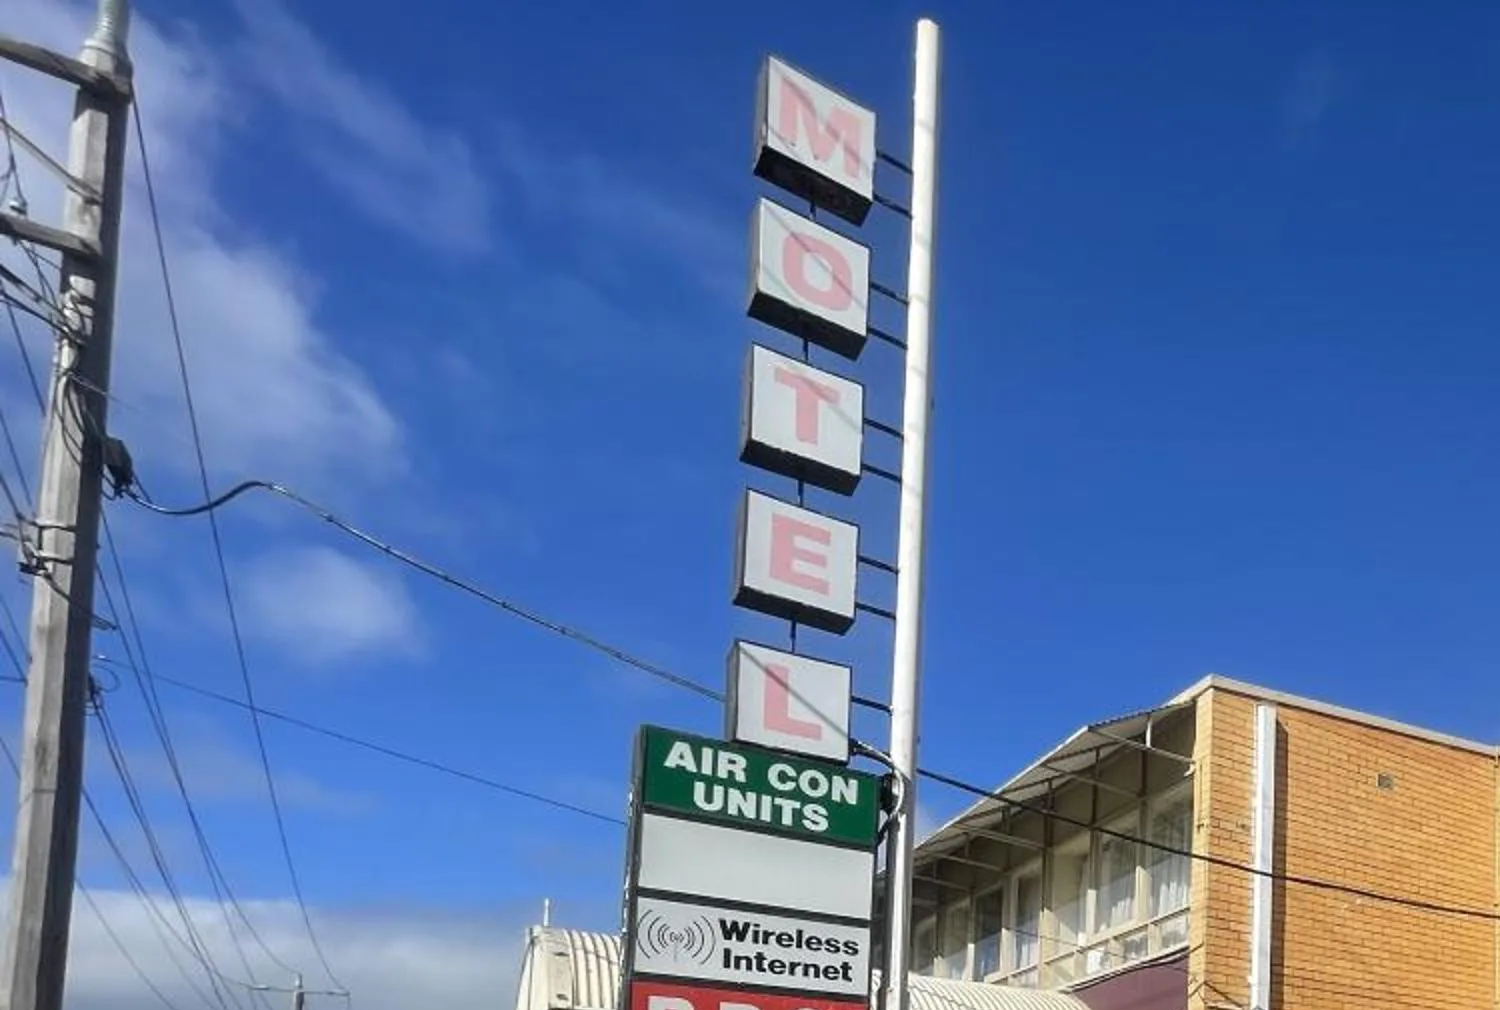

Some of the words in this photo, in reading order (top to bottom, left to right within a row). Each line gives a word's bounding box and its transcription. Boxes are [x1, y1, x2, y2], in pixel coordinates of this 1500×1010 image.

[764, 73, 865, 740] MOTEL
[663, 741, 747, 783] AIR
[768, 763, 859, 806] CON
[693, 781, 829, 833] UNITS
[719, 918, 860, 956] Wireless
[723, 948, 853, 983] Internet
